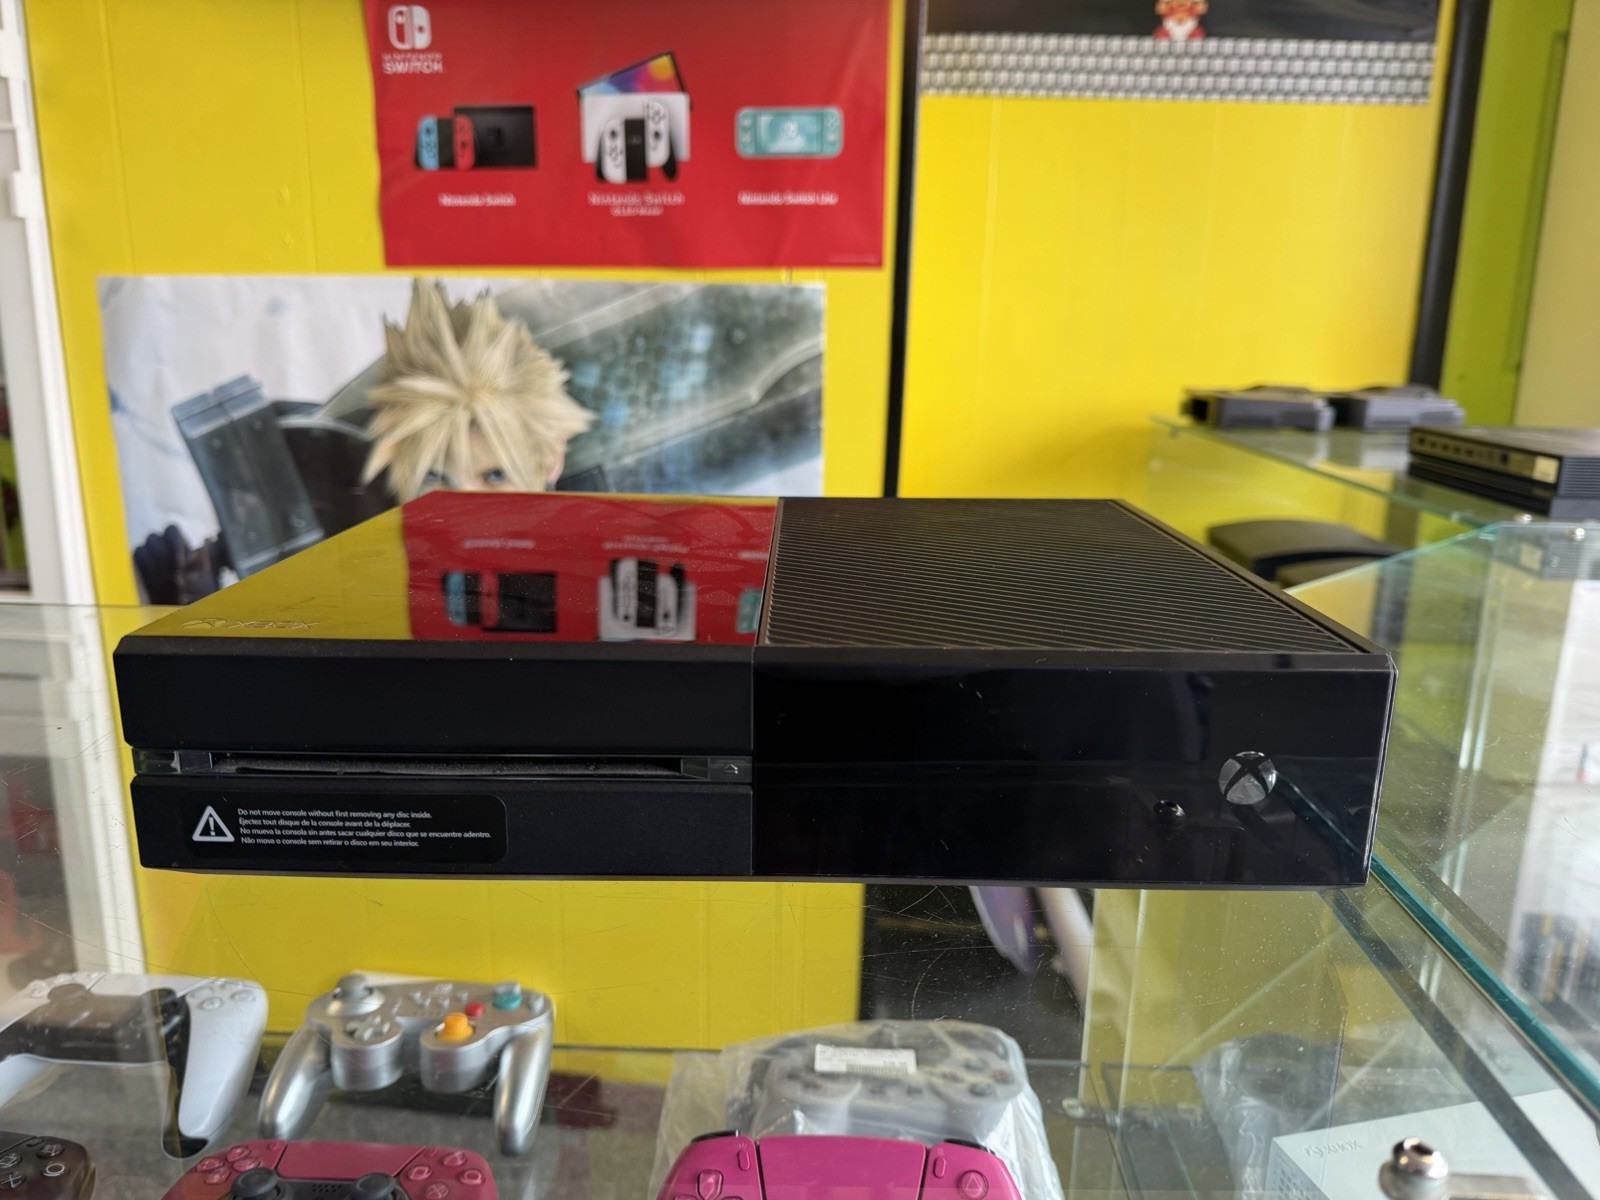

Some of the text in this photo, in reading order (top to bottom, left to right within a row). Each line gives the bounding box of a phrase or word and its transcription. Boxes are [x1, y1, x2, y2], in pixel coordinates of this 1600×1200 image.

[382, 60, 444, 74] SWITCH
[227, 620, 319, 630] XBOX
[350, 811, 381, 819] removing
[278, 819, 300, 827] disque
